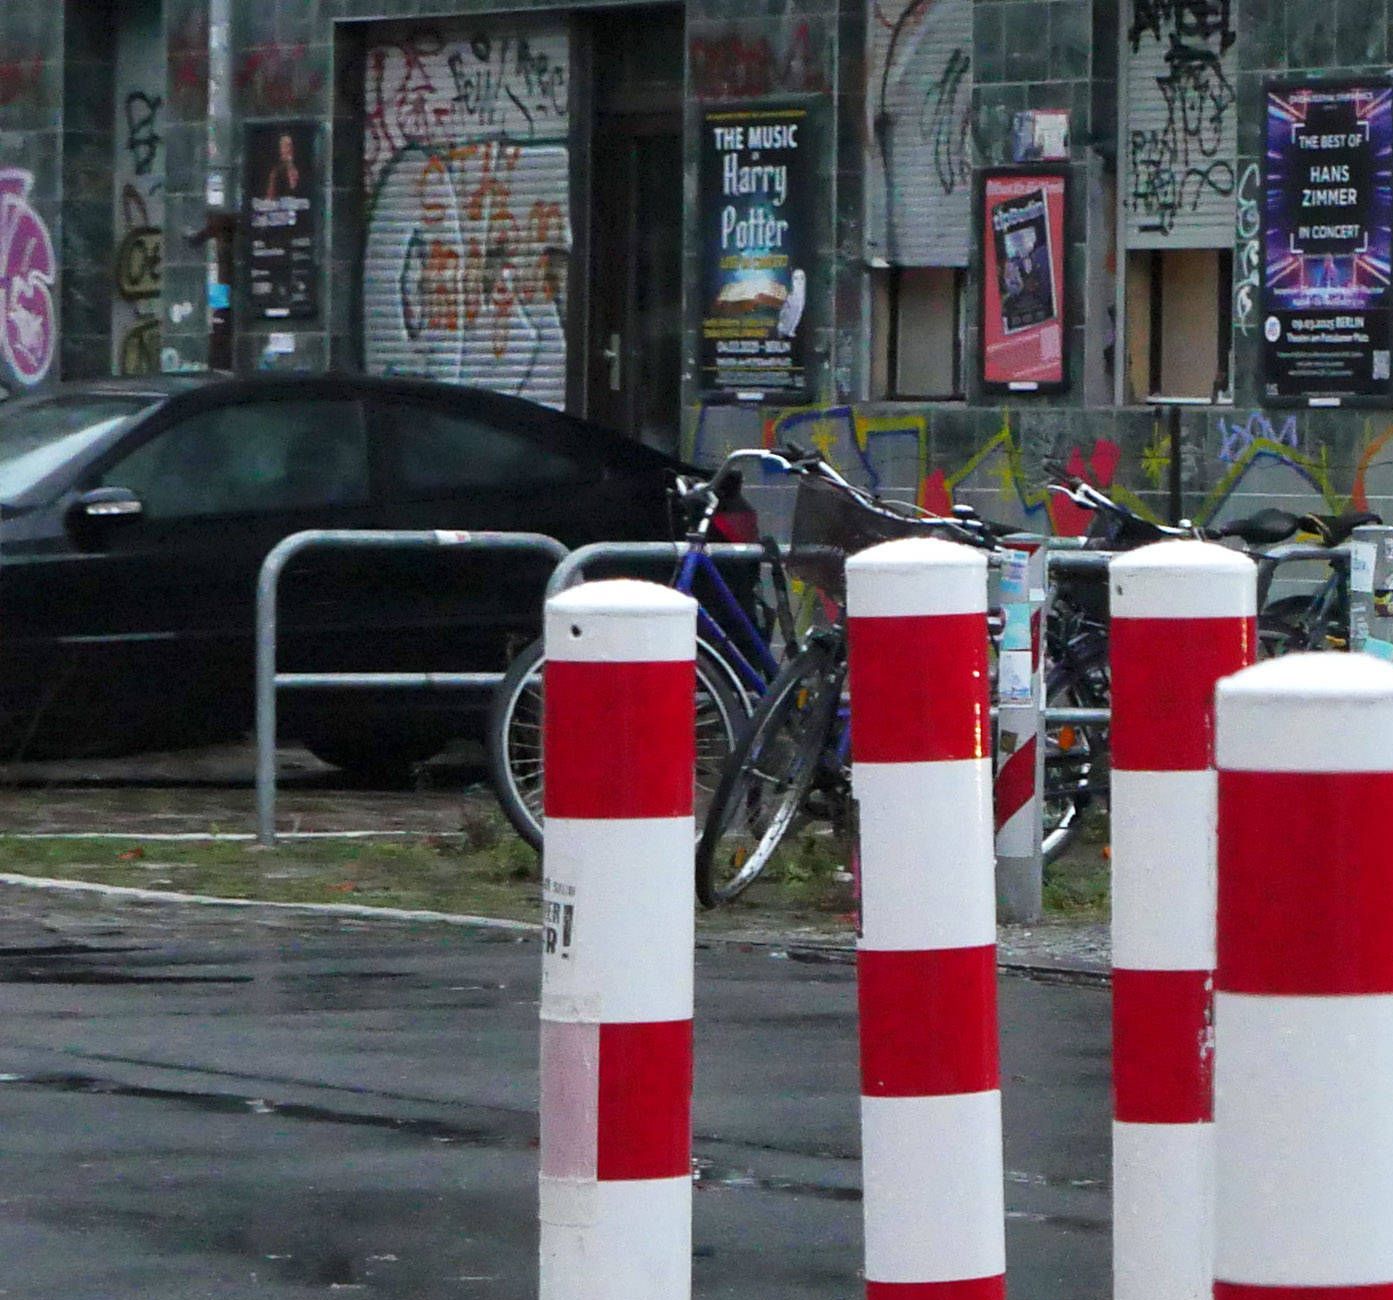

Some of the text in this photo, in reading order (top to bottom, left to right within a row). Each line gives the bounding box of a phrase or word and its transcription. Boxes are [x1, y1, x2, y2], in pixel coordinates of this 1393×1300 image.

[713, 124, 799, 150] THE MUSIC
[1299, 133, 1363, 149] THE BEST OF
[723, 152, 788, 207] Harry
[1310, 165, 1350, 183] HANS
[1302, 188, 1358, 207] ZIMMER
[722, 205, 789, 250] Potter
[1298, 225, 1361, 239] IN CONCERT
[1336, 316, 1365, 329] BERLIN
